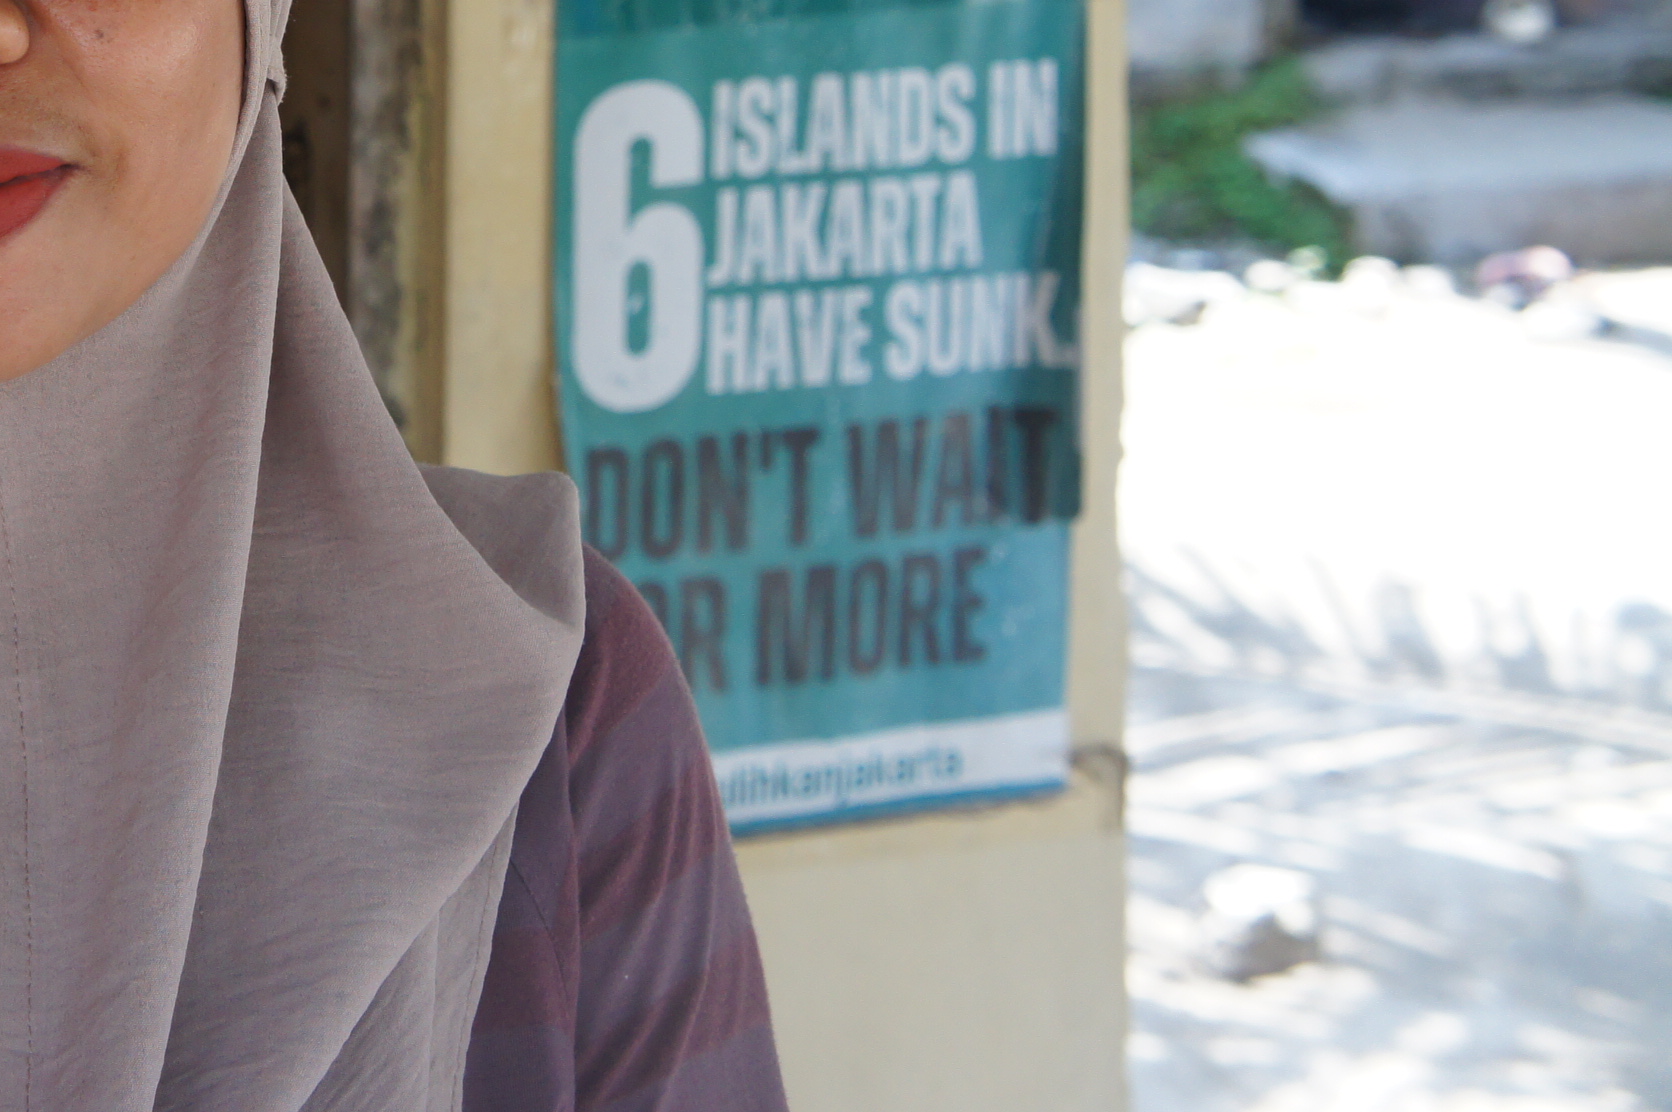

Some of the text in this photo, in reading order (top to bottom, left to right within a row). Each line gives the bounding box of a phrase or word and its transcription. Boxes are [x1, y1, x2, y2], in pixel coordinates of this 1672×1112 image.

[711, 56, 1059, 180] ISLANDS IN
[571, 78, 705, 413] 6
[706, 169, 984, 289] JAKARTA
[704, 282, 874, 396] HAVE
[584, 405, 1061, 563] DON'T WAIT
[755, 543, 989, 686] MORE
